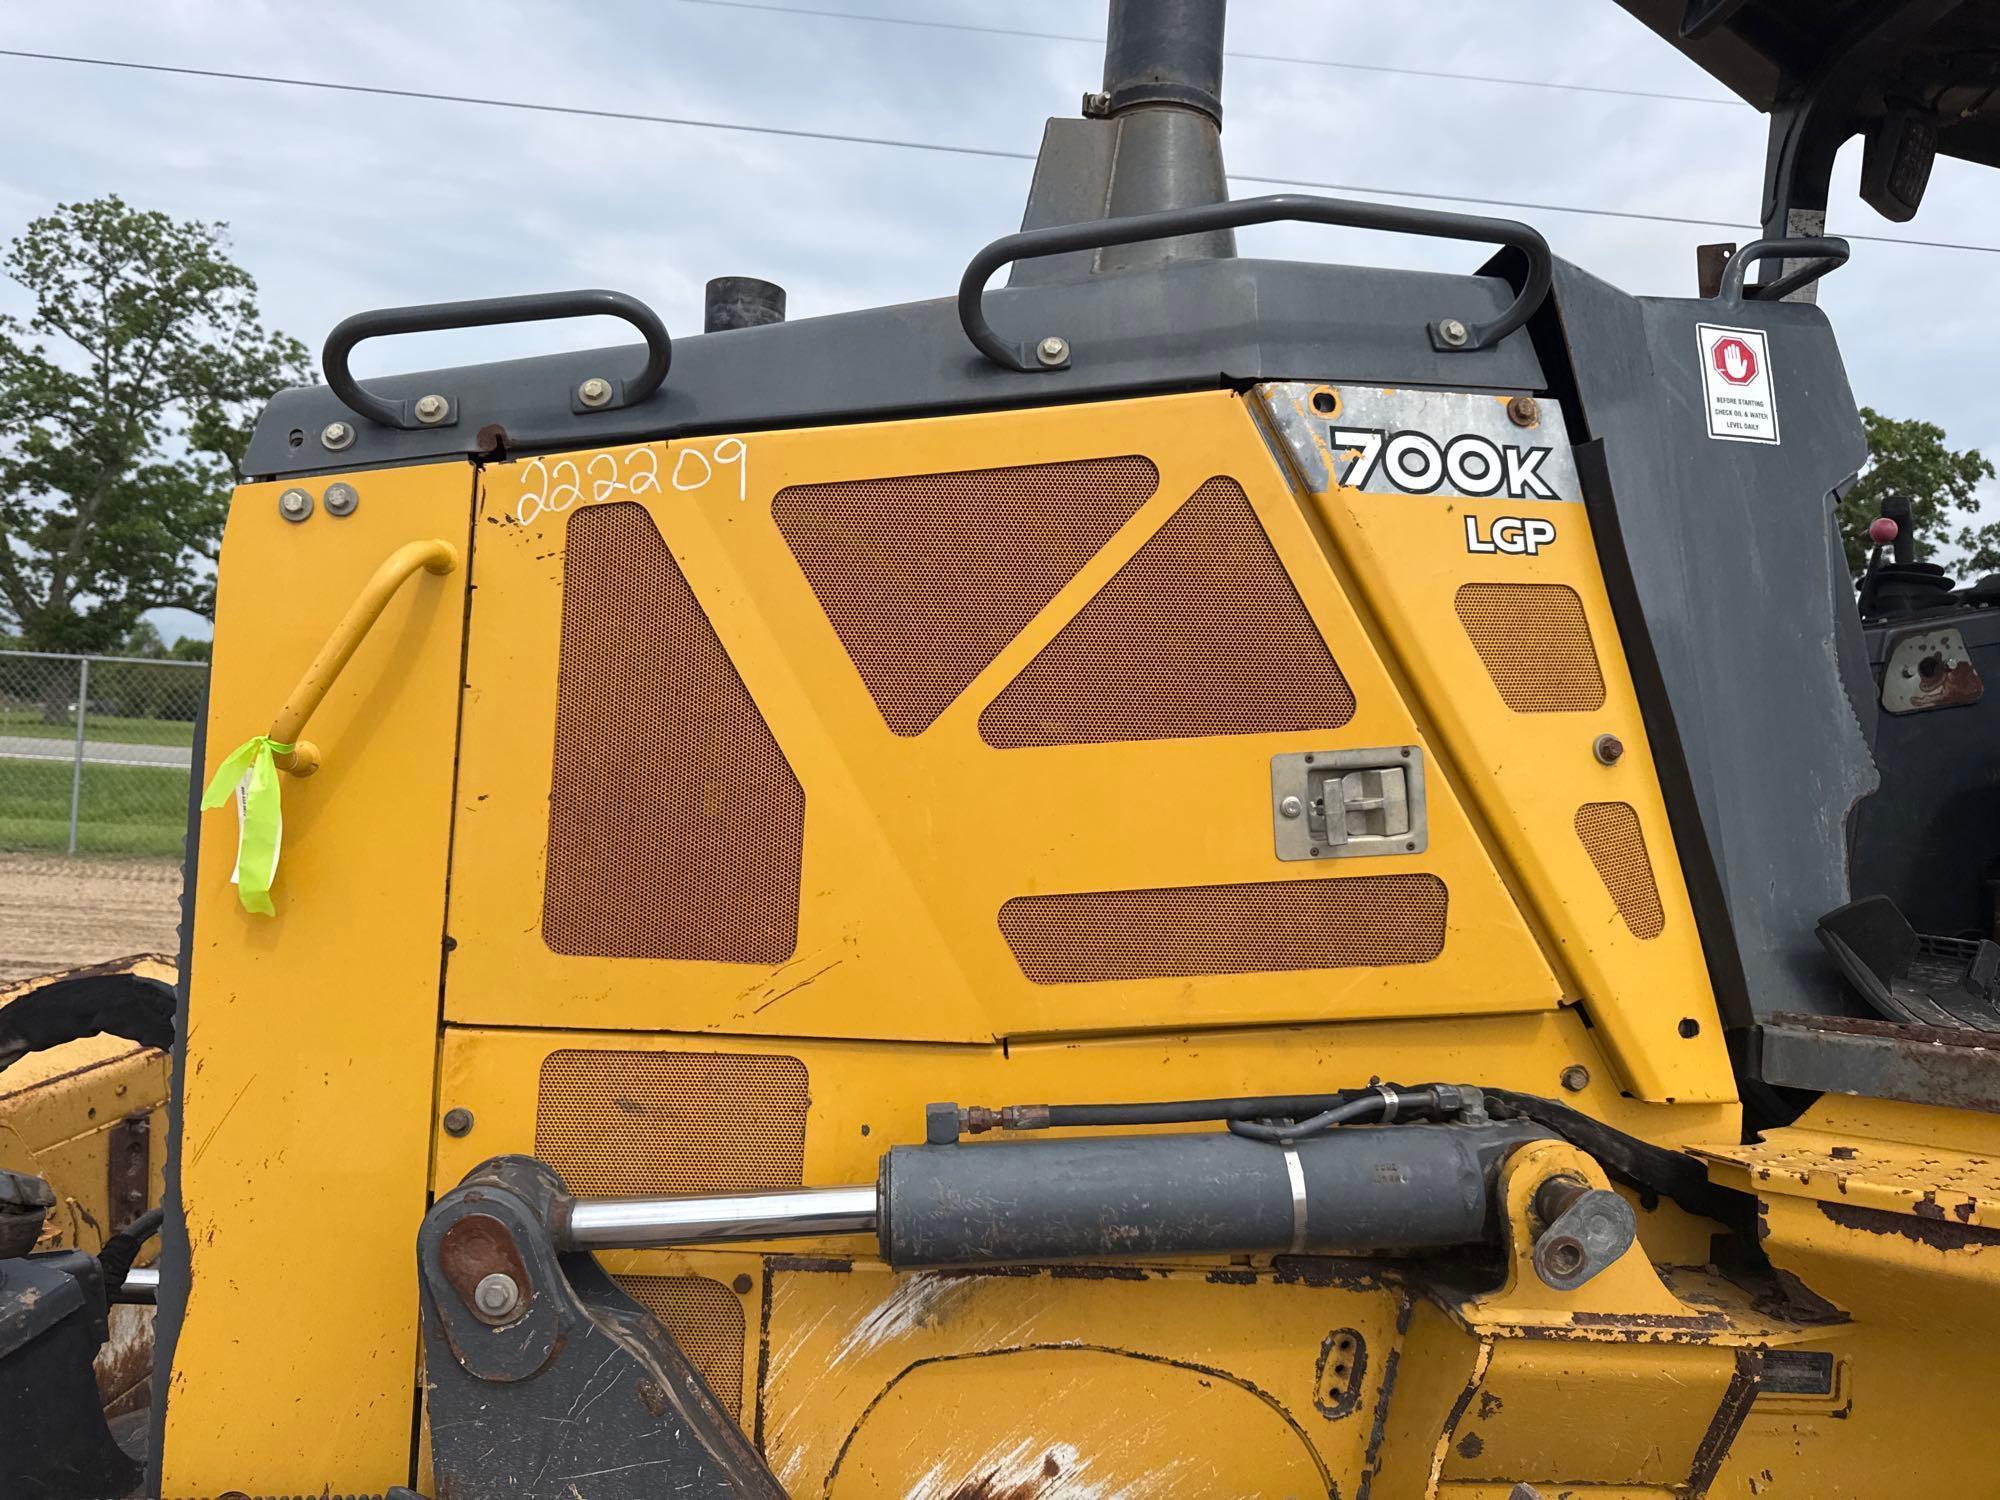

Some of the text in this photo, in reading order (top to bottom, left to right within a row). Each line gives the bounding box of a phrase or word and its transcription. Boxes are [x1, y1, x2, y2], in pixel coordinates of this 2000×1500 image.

[1715, 408, 1733, 416] CHECK
[1750, 412, 1768, 420] WATER
[1716, 397, 1764, 407] BEFORE STARTING
[1744, 423, 1759, 431] DAILY
[1329, 425, 1562, 500] 700K
[517, 438, 747, 526] 222209
[1464, 514, 1556, 556] LGP
